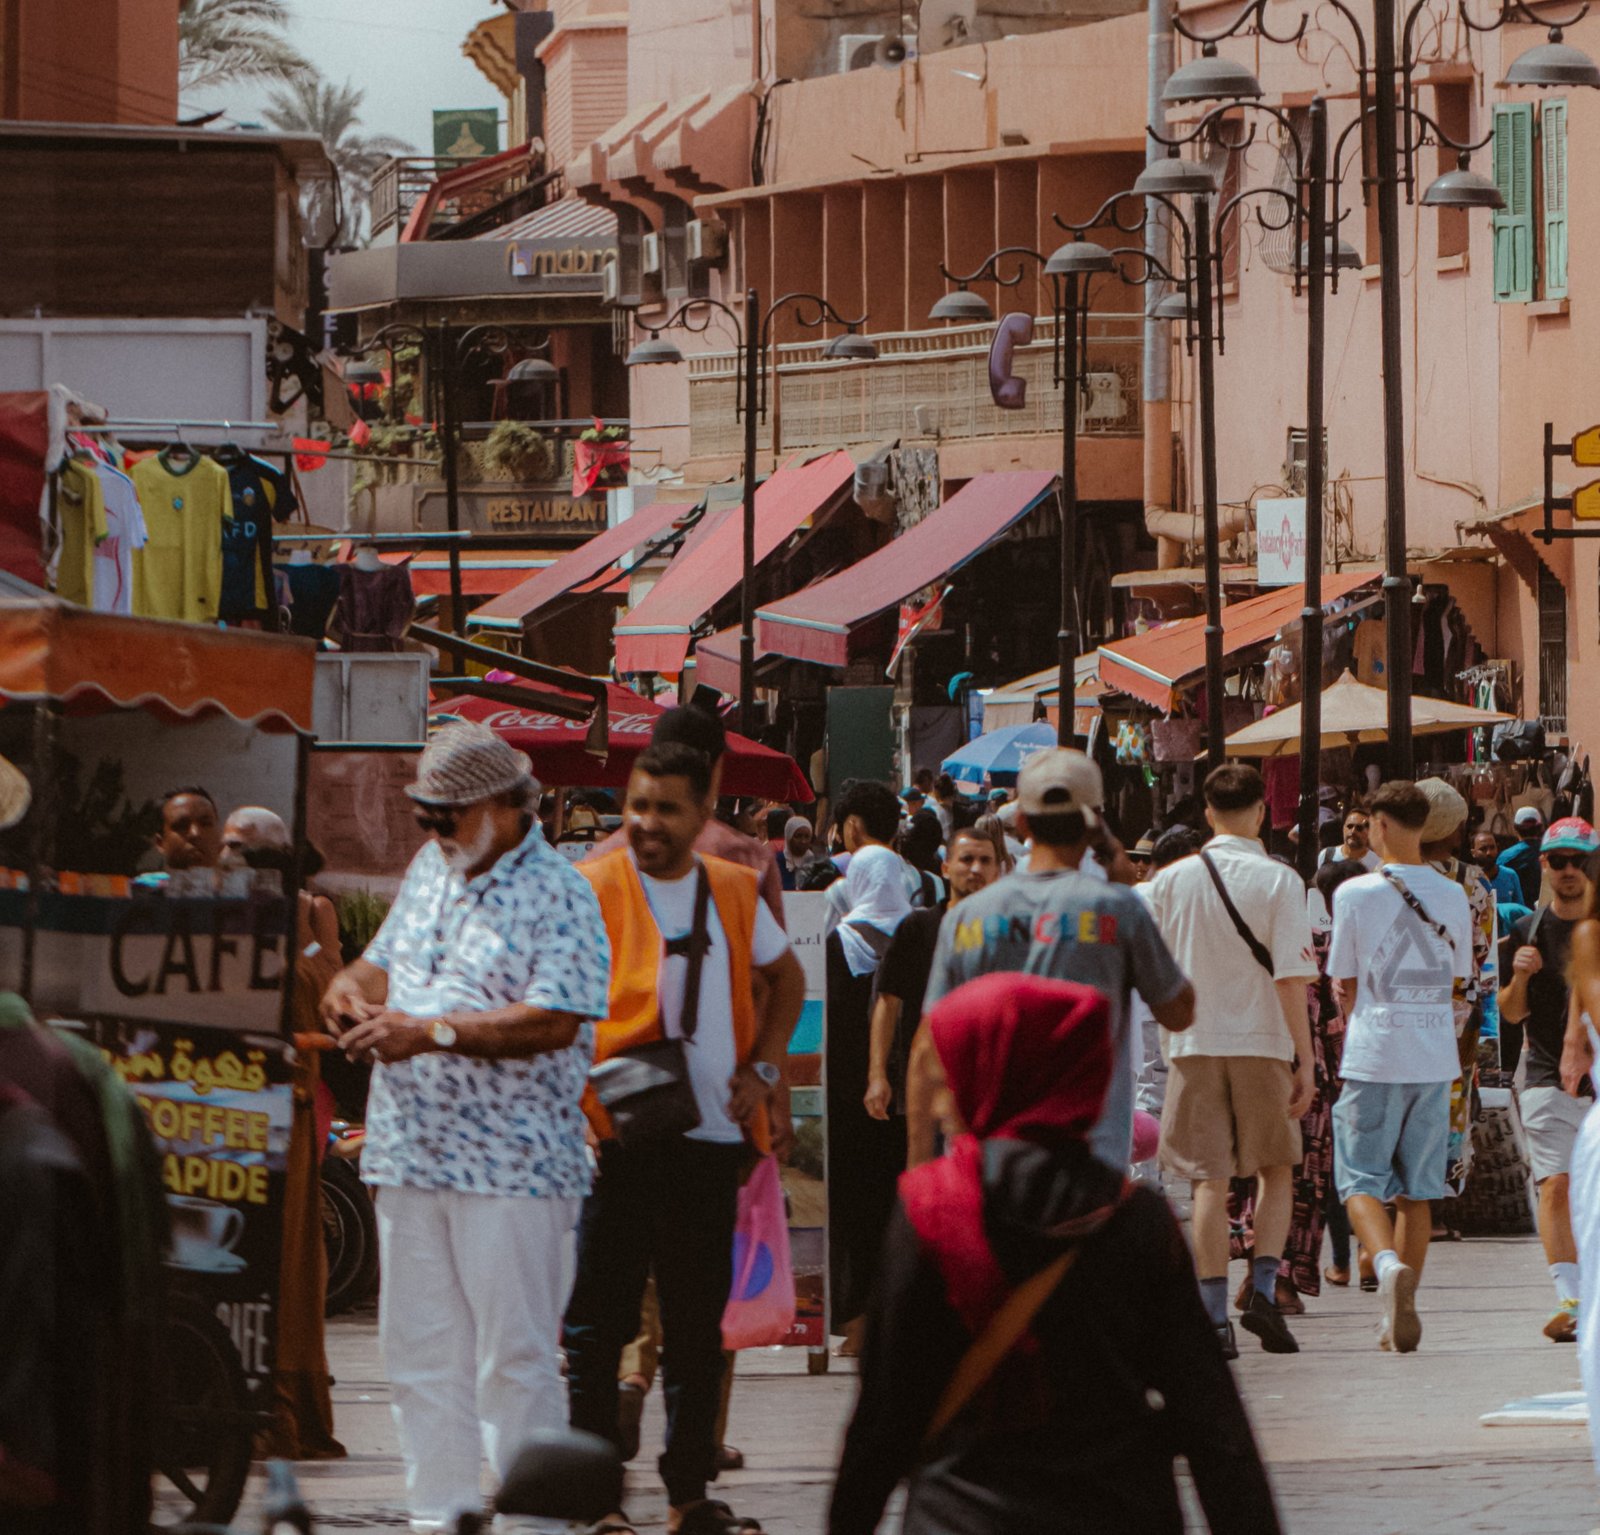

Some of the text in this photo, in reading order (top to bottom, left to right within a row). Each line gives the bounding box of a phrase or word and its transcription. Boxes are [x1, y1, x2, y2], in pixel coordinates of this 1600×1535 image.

[487, 500, 606, 523] RESTAURANT
[954, 911, 1119, 954] MONCLER
[170, 1038, 267, 1096] قهوة
[136, 1093, 270, 1151] OFFEE
